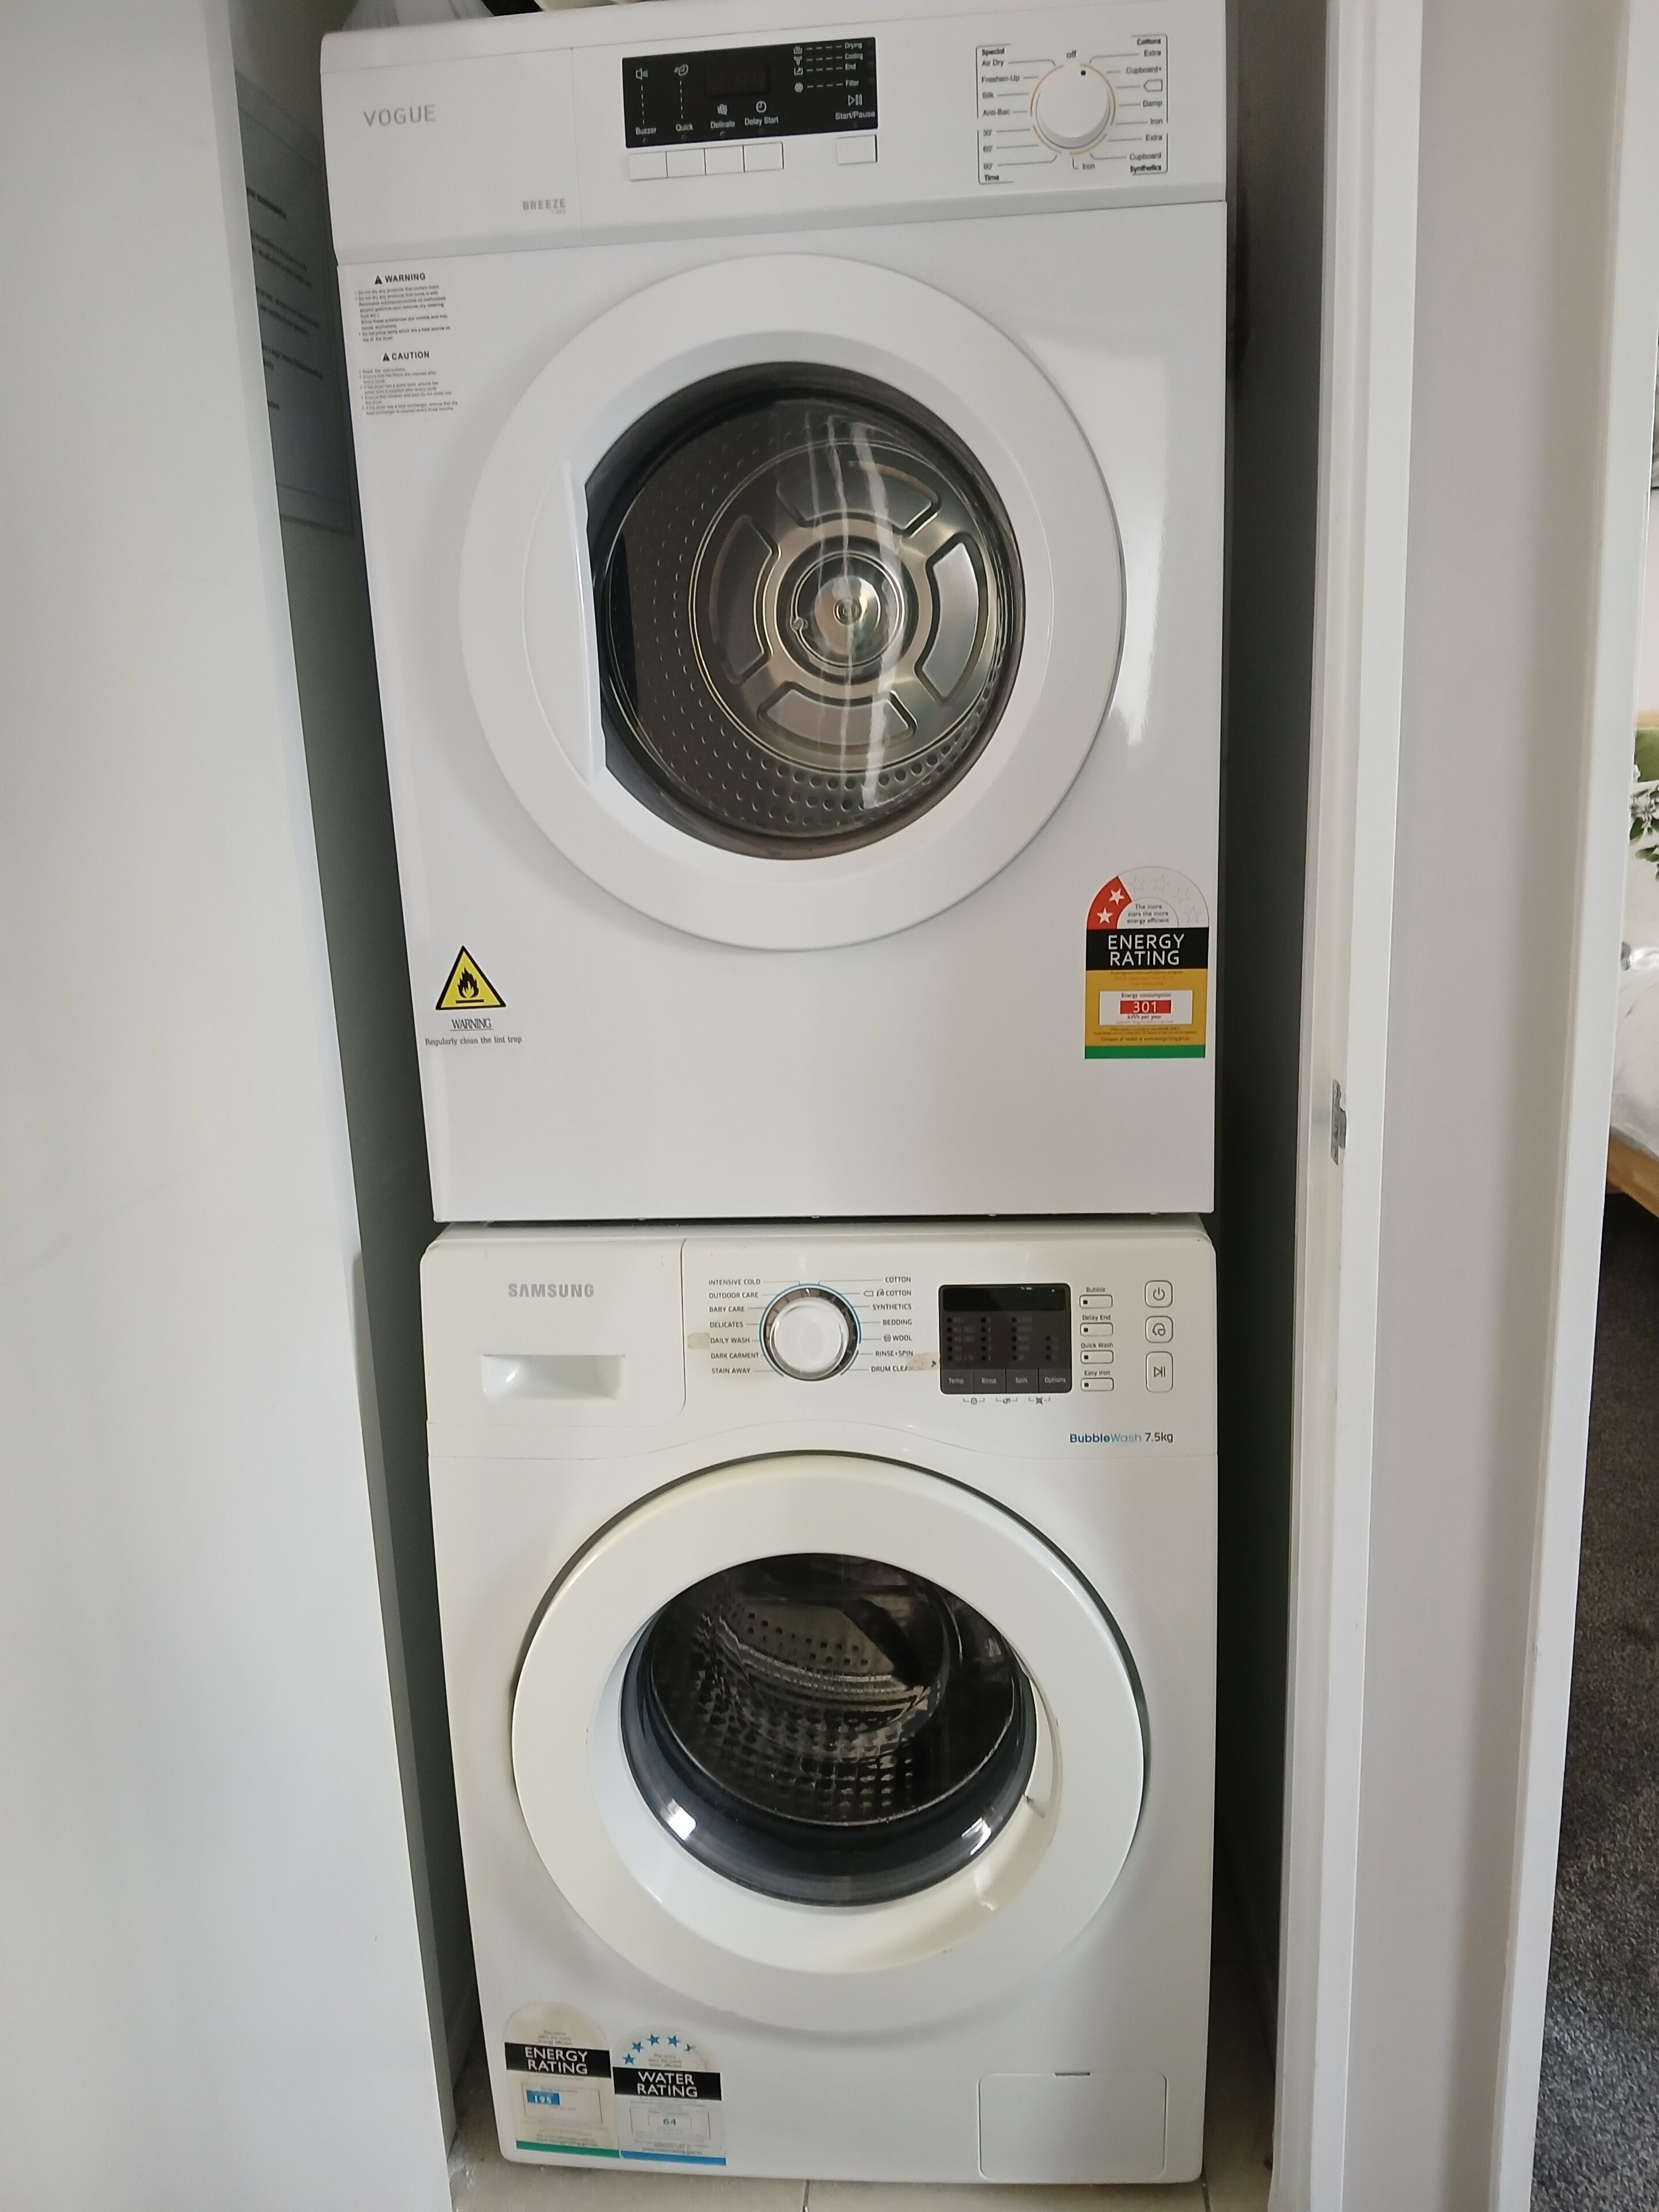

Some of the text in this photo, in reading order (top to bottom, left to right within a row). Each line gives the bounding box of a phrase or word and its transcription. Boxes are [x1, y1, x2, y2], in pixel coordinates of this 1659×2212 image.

[1137, 37, 1161, 46] Cottons
[982, 47, 1005, 56] Special
[1066, 50, 1077, 59] off
[993, 59, 1004, 67] Dry
[982, 74, 1020, 84] Freshen-Up
[1143, 100, 1162, 108] Damp
[363, 104, 436, 127] VOGUE
[835, 111, 876, 120] Start/Pause
[983, 108, 1010, 116] Anti-Bac
[710, 119, 735, 128] Delicate
[745, 116, 779, 126] Delay Start
[635, 126, 657, 135] Buzzer
[676, 123, 693, 132] Quick
[1130, 152, 1162, 161] Cupboard
[1130, 164, 1162, 174] Synthetics
[522, 198, 566, 211] BREEZE
[384, 272, 426, 283] WARNING
[392, 350, 430, 361] CAUTION
[1108, 933, 1185, 950] ENERGY
[1109, 950, 1180, 967] RATING
[1132, 1001, 1157, 1013] 301
[451, 1018, 492, 1029] WARNING
[425, 1036, 522, 1047] Regularly clean the lint trap
[508, 1283, 594, 1298] SAMSUNG
[1082, 1314, 1097, 1322] Delay
[1084, 1369, 1097, 1377] Easy
[1015, 1377, 1028, 1385] Spin
[1044, 1376, 1066, 1384] Options
[1069, 1431, 1174, 1444] BubbleWash 7.5kg
[524, 2046, 588, 2062] ENERGY
[528, 2059, 588, 2075] RATING
[638, 2070, 695, 2085] WATER
[637, 2083, 698, 2098] RATING
[662, 2118, 677, 2126] 64
